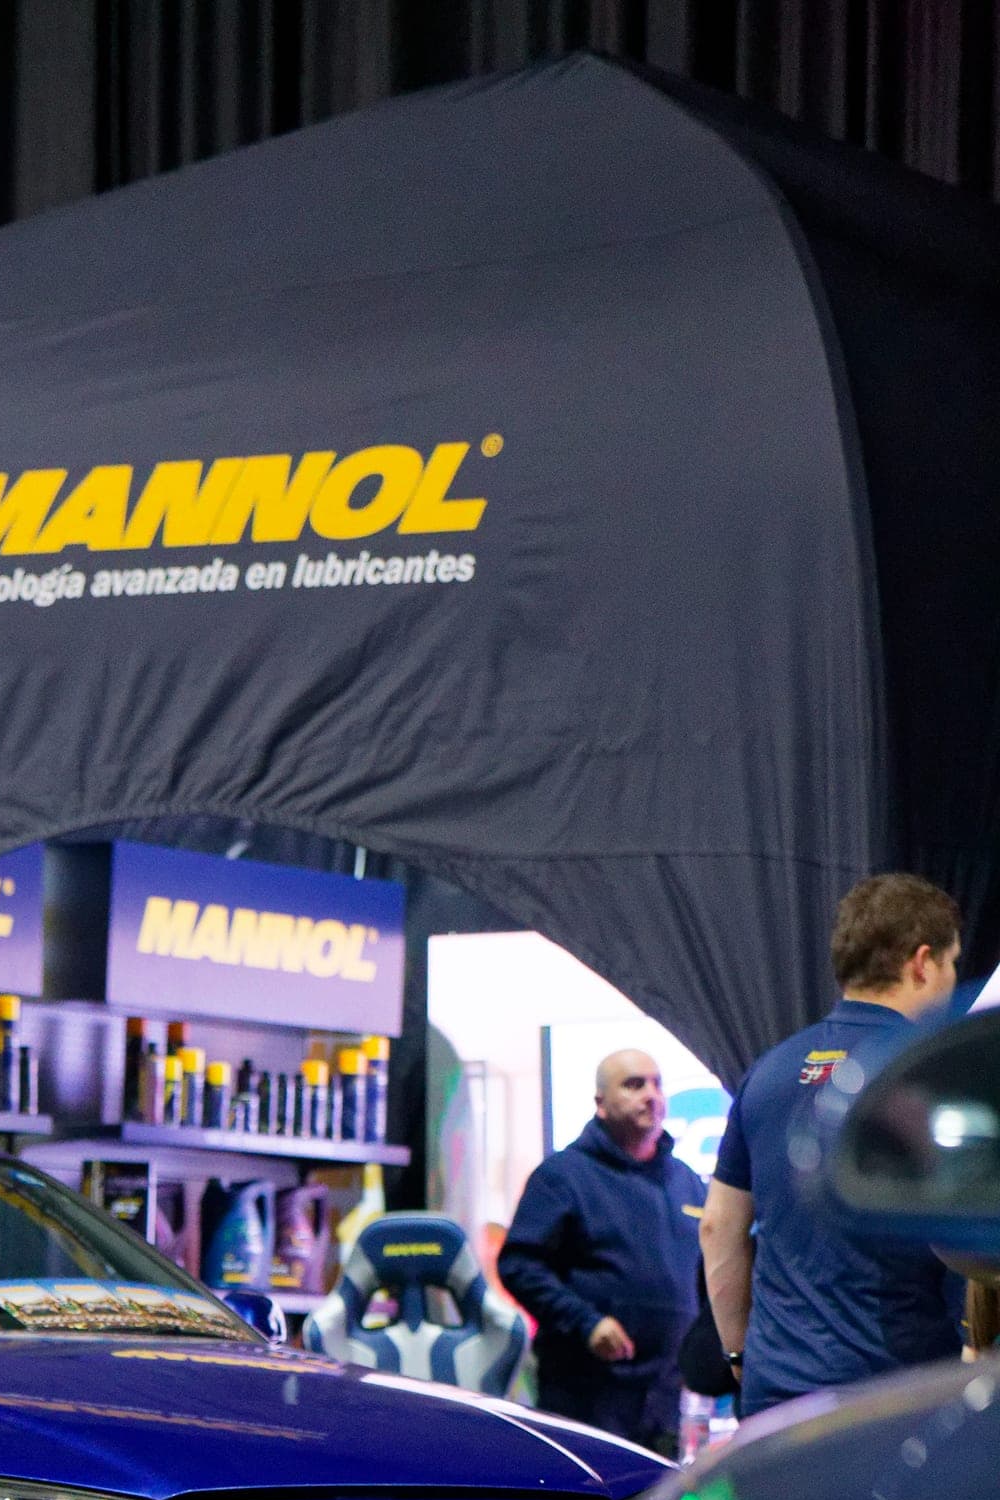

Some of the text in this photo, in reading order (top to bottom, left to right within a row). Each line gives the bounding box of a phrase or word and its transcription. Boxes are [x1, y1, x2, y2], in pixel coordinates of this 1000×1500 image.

[90, 557, 240, 598] avanzada
[244, 561, 288, 590] en
[291, 549, 476, 588] lubricantes
[136, 896, 378, 983] MANNOL
